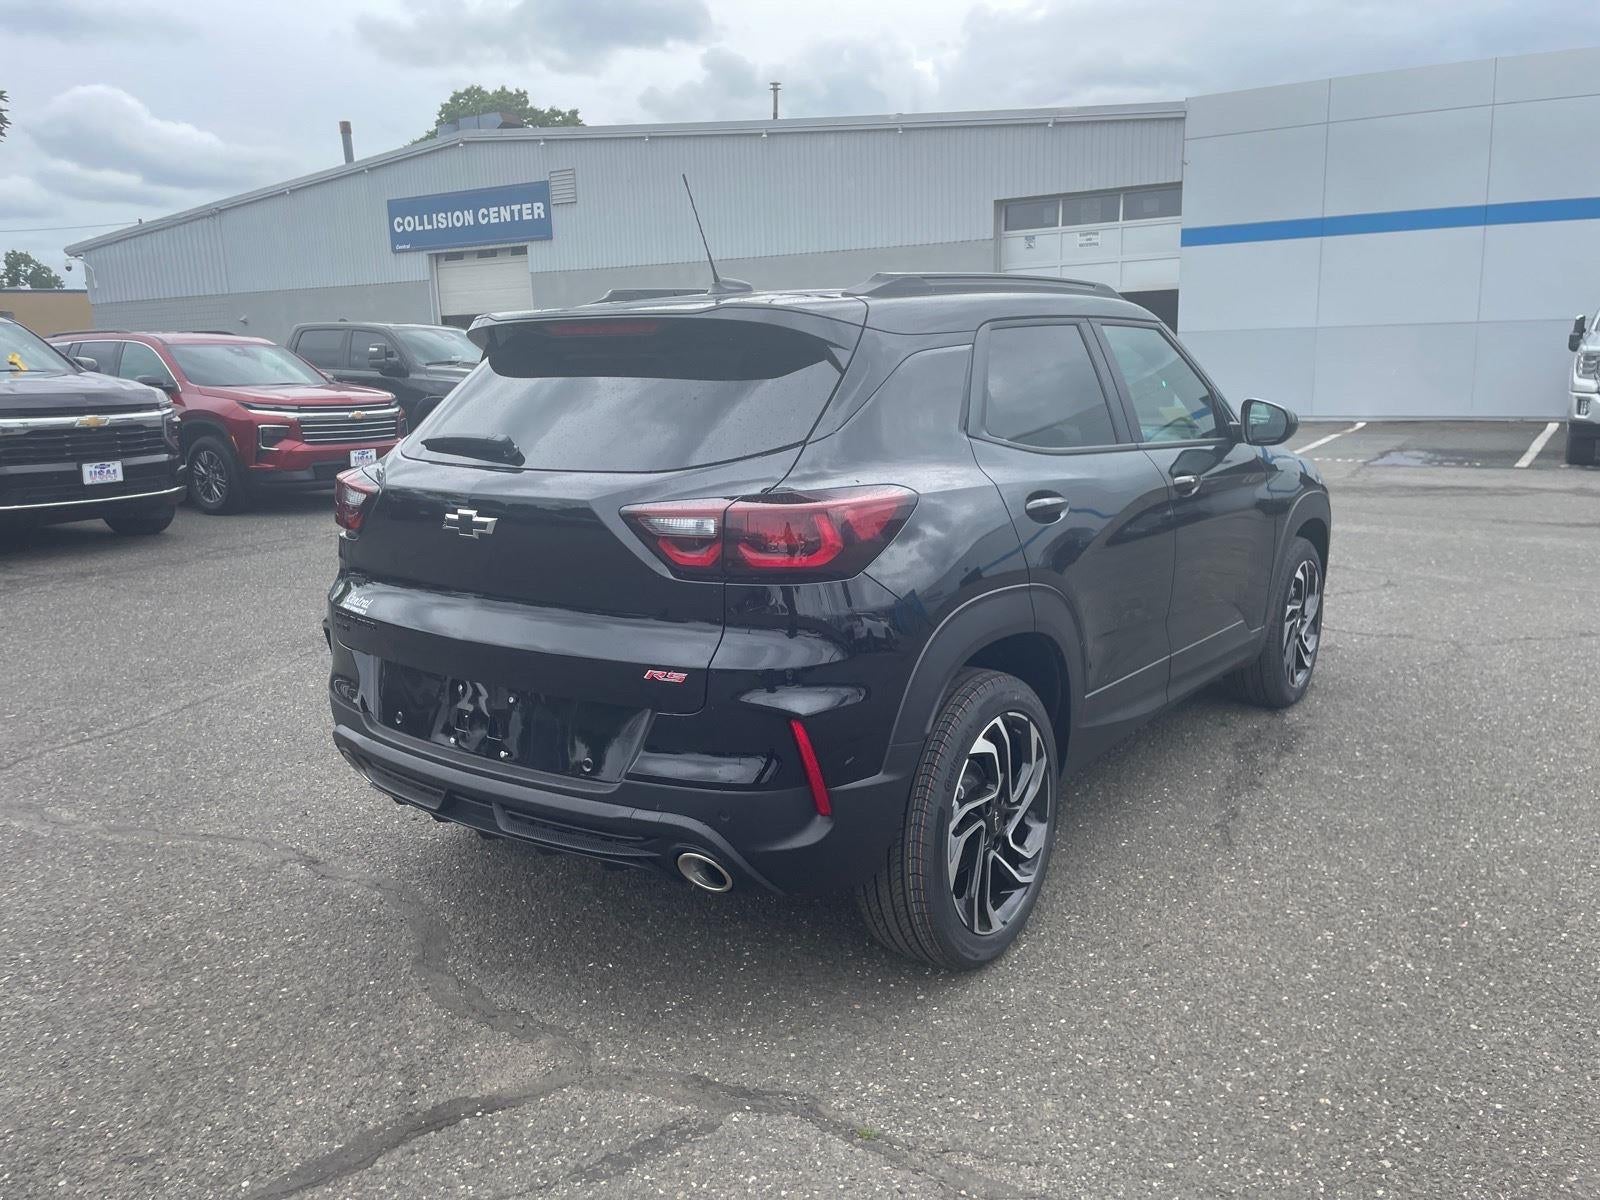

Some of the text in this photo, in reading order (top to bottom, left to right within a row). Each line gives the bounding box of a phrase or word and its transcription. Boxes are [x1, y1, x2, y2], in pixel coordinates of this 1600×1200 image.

[393, 202, 545, 233] COLLISION CENTER
[346, 591, 374, 609] Central
[643, 669, 688, 683] RS
